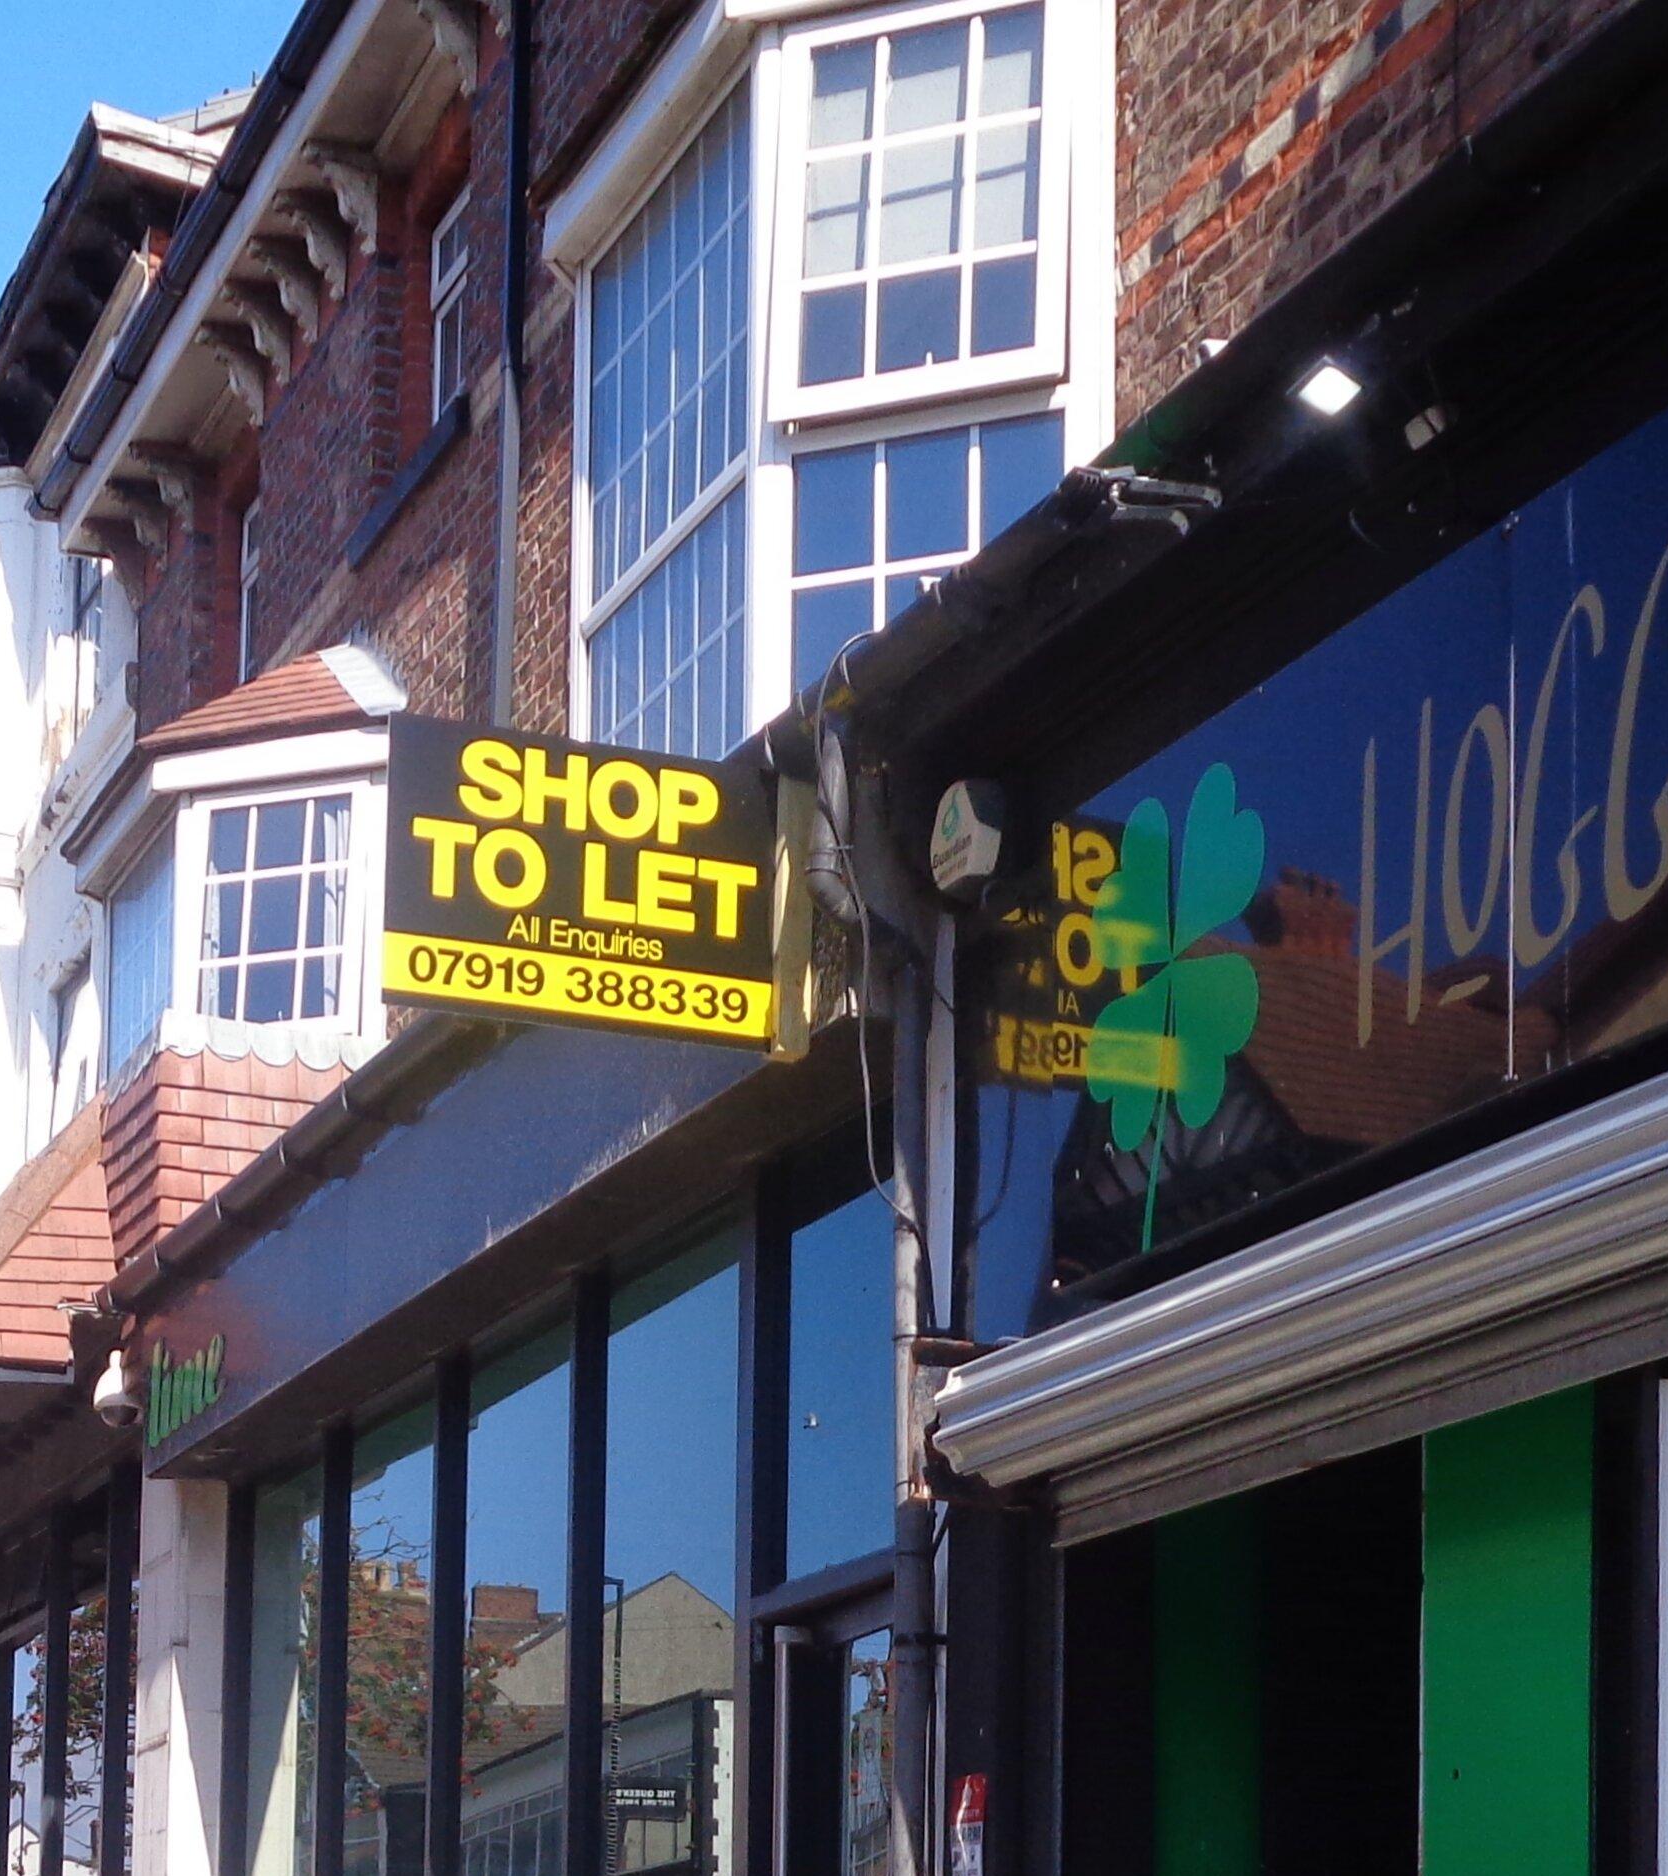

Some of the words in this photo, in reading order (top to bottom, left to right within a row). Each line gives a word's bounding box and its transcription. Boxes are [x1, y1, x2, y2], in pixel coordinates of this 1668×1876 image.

[457, 737, 721, 845] SHOP
[411, 815, 547, 910] TO
[582, 844, 758, 941] LET
[931, 832, 973, 870] Guardian
[507, 911, 543, 943] All
[547, 918, 665, 962] Enquiries
[407, 946, 547, 996] 07919
[564, 965, 750, 1024] 388339
[148, 1333, 226, 1449] lime
